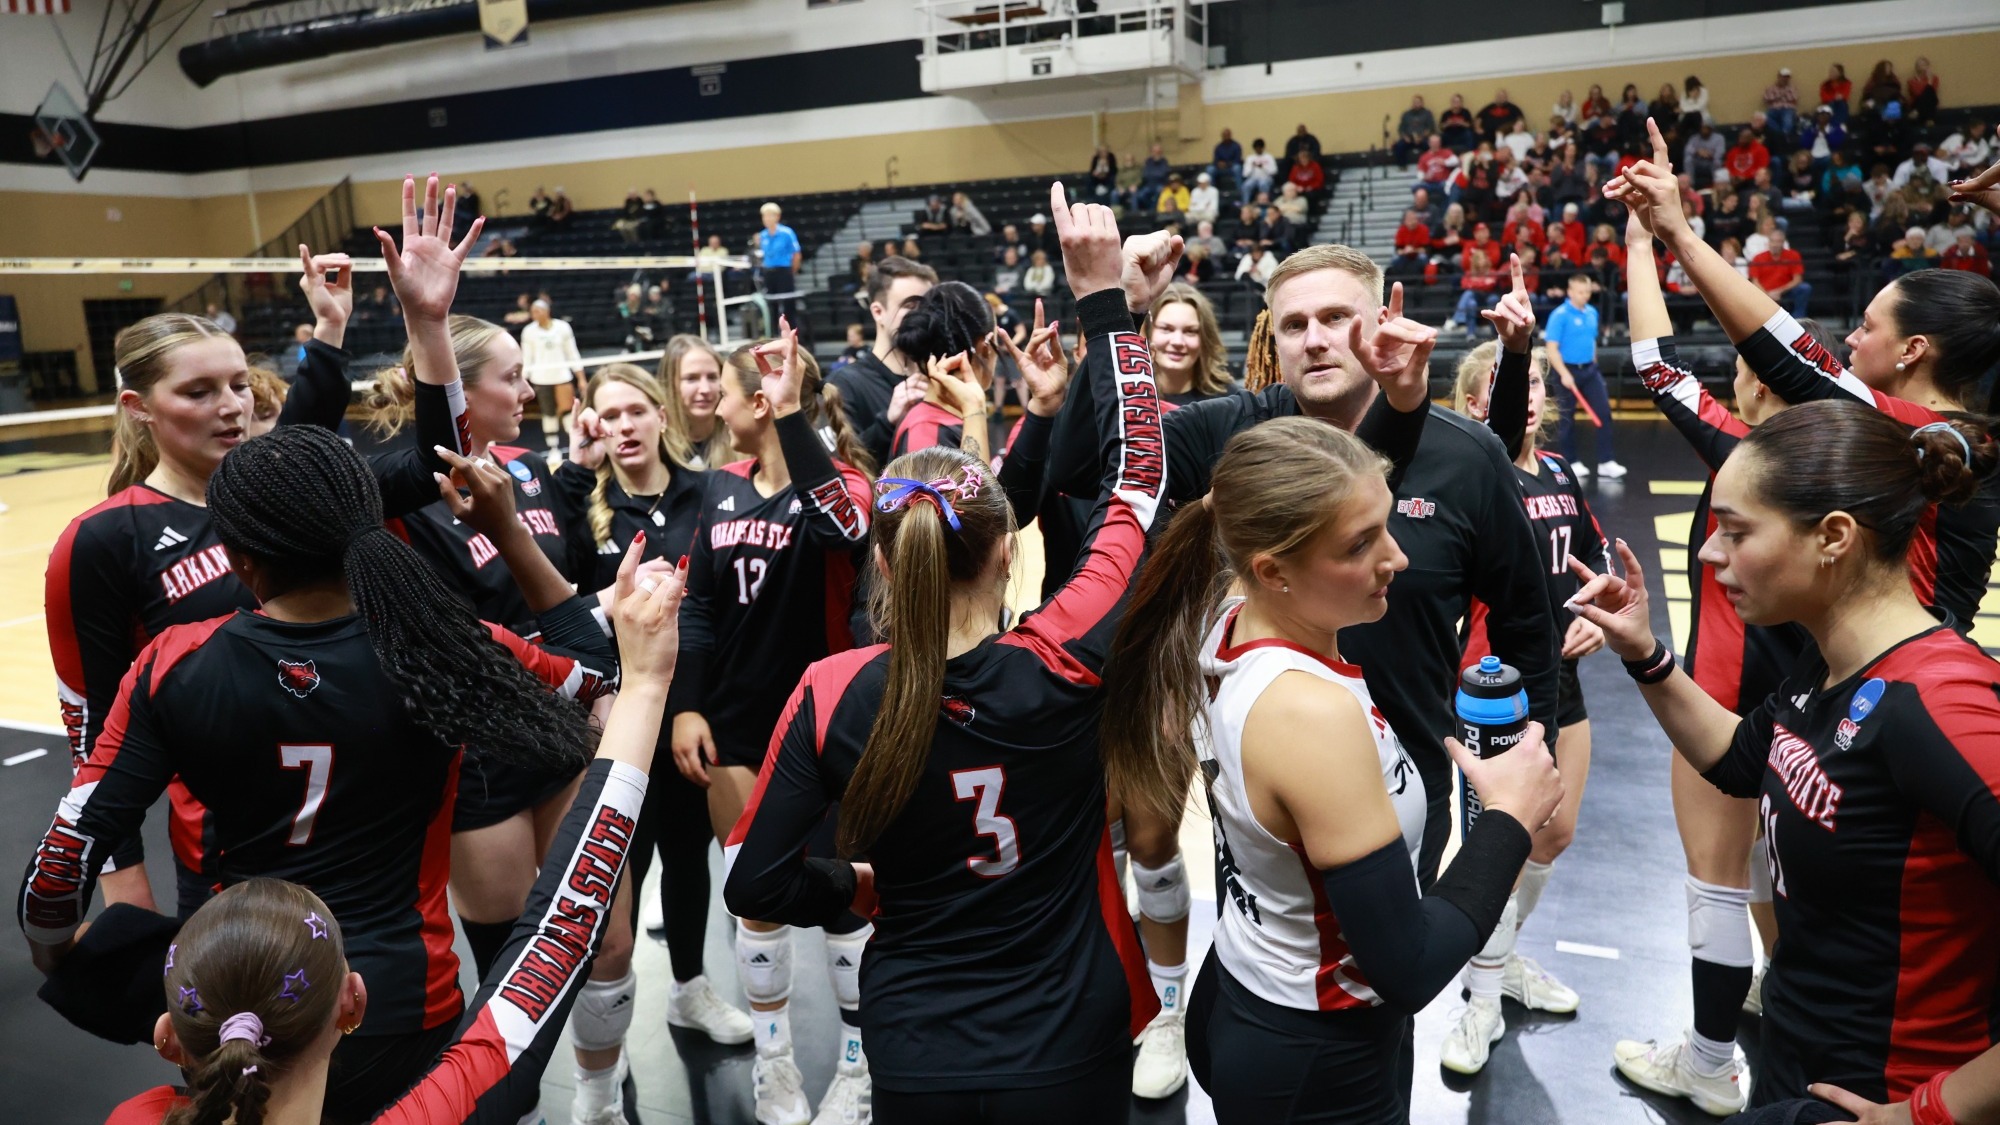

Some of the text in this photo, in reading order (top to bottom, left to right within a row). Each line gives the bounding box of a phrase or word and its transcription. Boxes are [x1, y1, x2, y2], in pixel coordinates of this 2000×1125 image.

[733, 556, 767, 605] 12
[1550, 525, 1572, 574] 17
[277, 742, 335, 847] 7
[949, 764, 1021, 878] 3
[1786, 752, 1844, 833] STATE
[568, 803, 636, 907] STATE
